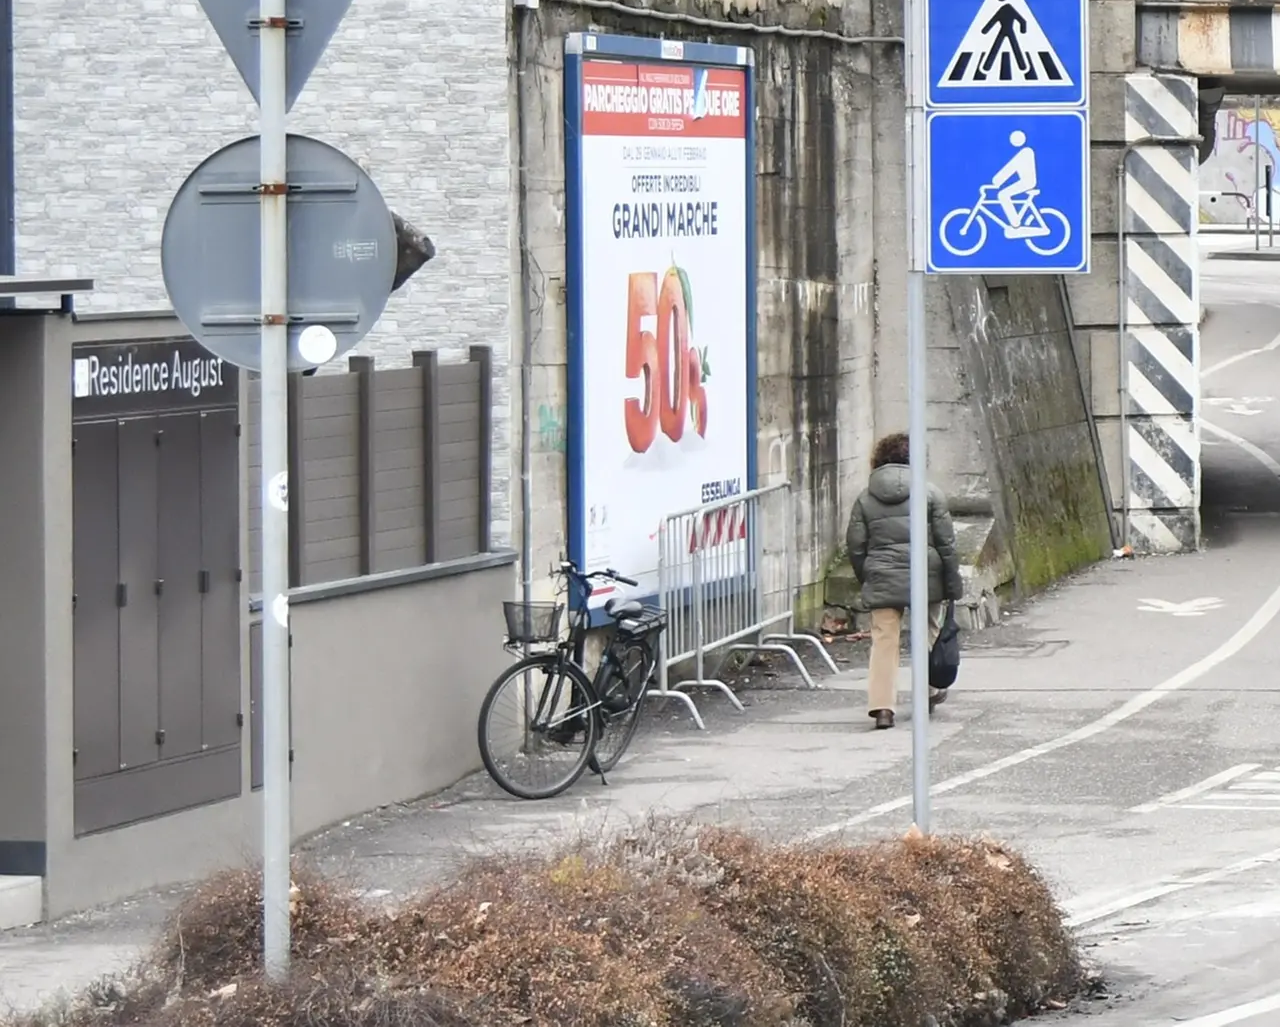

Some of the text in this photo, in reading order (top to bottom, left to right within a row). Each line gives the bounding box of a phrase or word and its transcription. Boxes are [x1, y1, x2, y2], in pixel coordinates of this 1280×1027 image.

[584, 83, 648, 114] PARCHEGGIO
[649, 86, 682, 115] GRATIS
[721, 91, 740, 117] ORE
[632, 175, 701, 193] OFFERTE INCREDIBILI
[612, 201, 718, 239] GRANDI MARCHE
[88, 350, 224, 397] Residence August
[701, 477, 741, 504] ESSELUNGA
